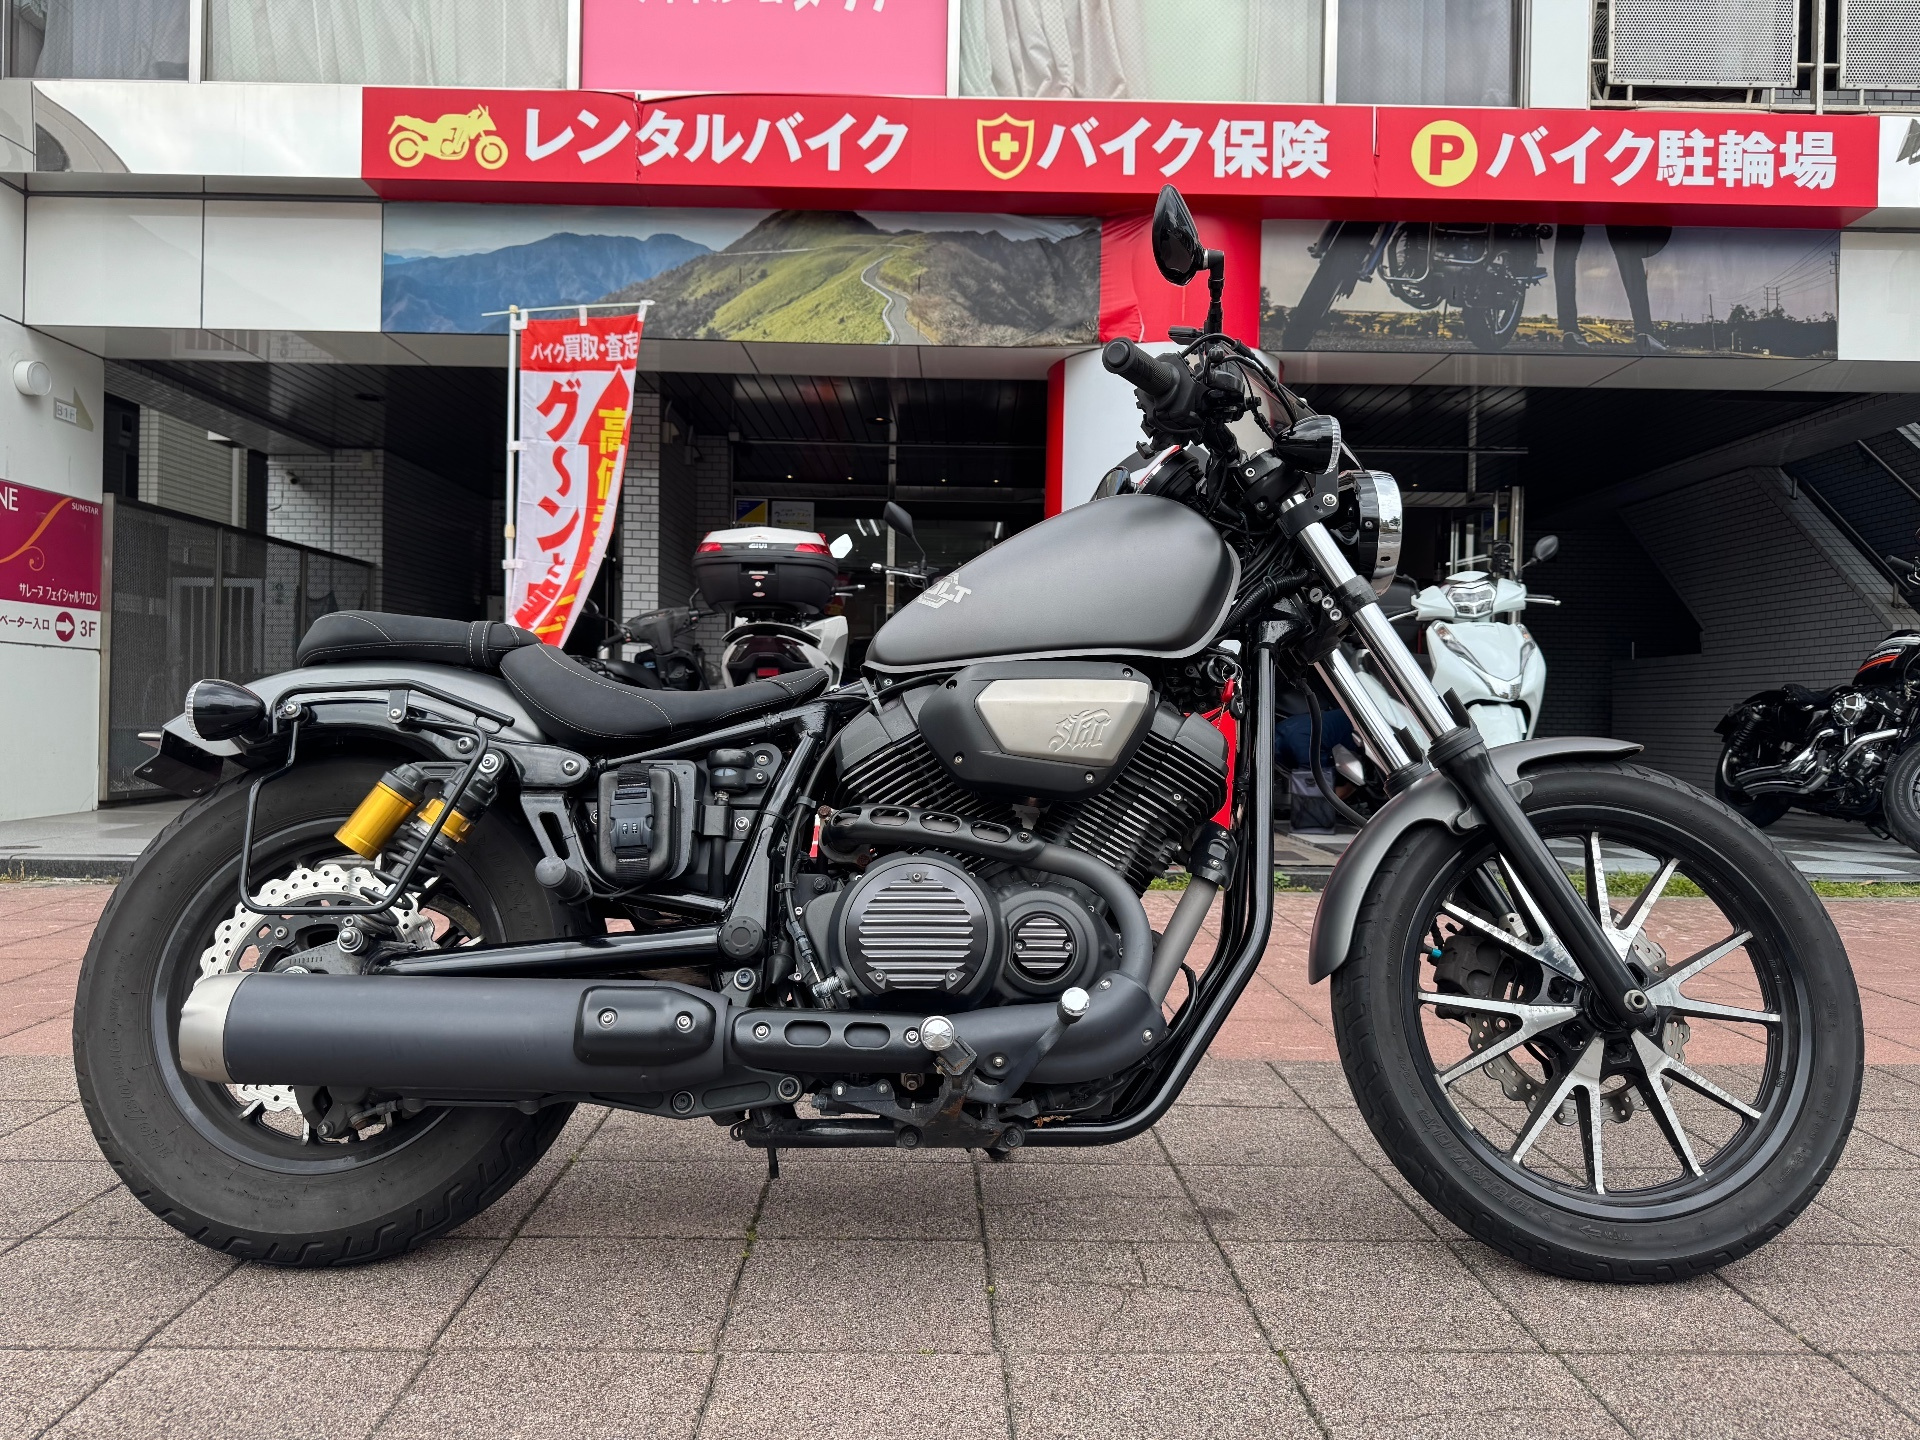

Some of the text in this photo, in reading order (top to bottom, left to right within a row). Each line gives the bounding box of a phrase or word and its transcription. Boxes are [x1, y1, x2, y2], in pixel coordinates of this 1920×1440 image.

[526, 107, 908, 173] レンタルバイク
[1037, 117, 1331, 179] バイク保険
[1429, 134, 1465, 176] P
[1486, 126, 1838, 190] バイク駐輪場
[530, 330, 639, 364] バイク買取・査定
[71, 502, 99, 516] SUNSTAR
[19, 583, 98, 606] サレーヌ フェイシャルサロン
[80, 620, 97, 638] 3F
